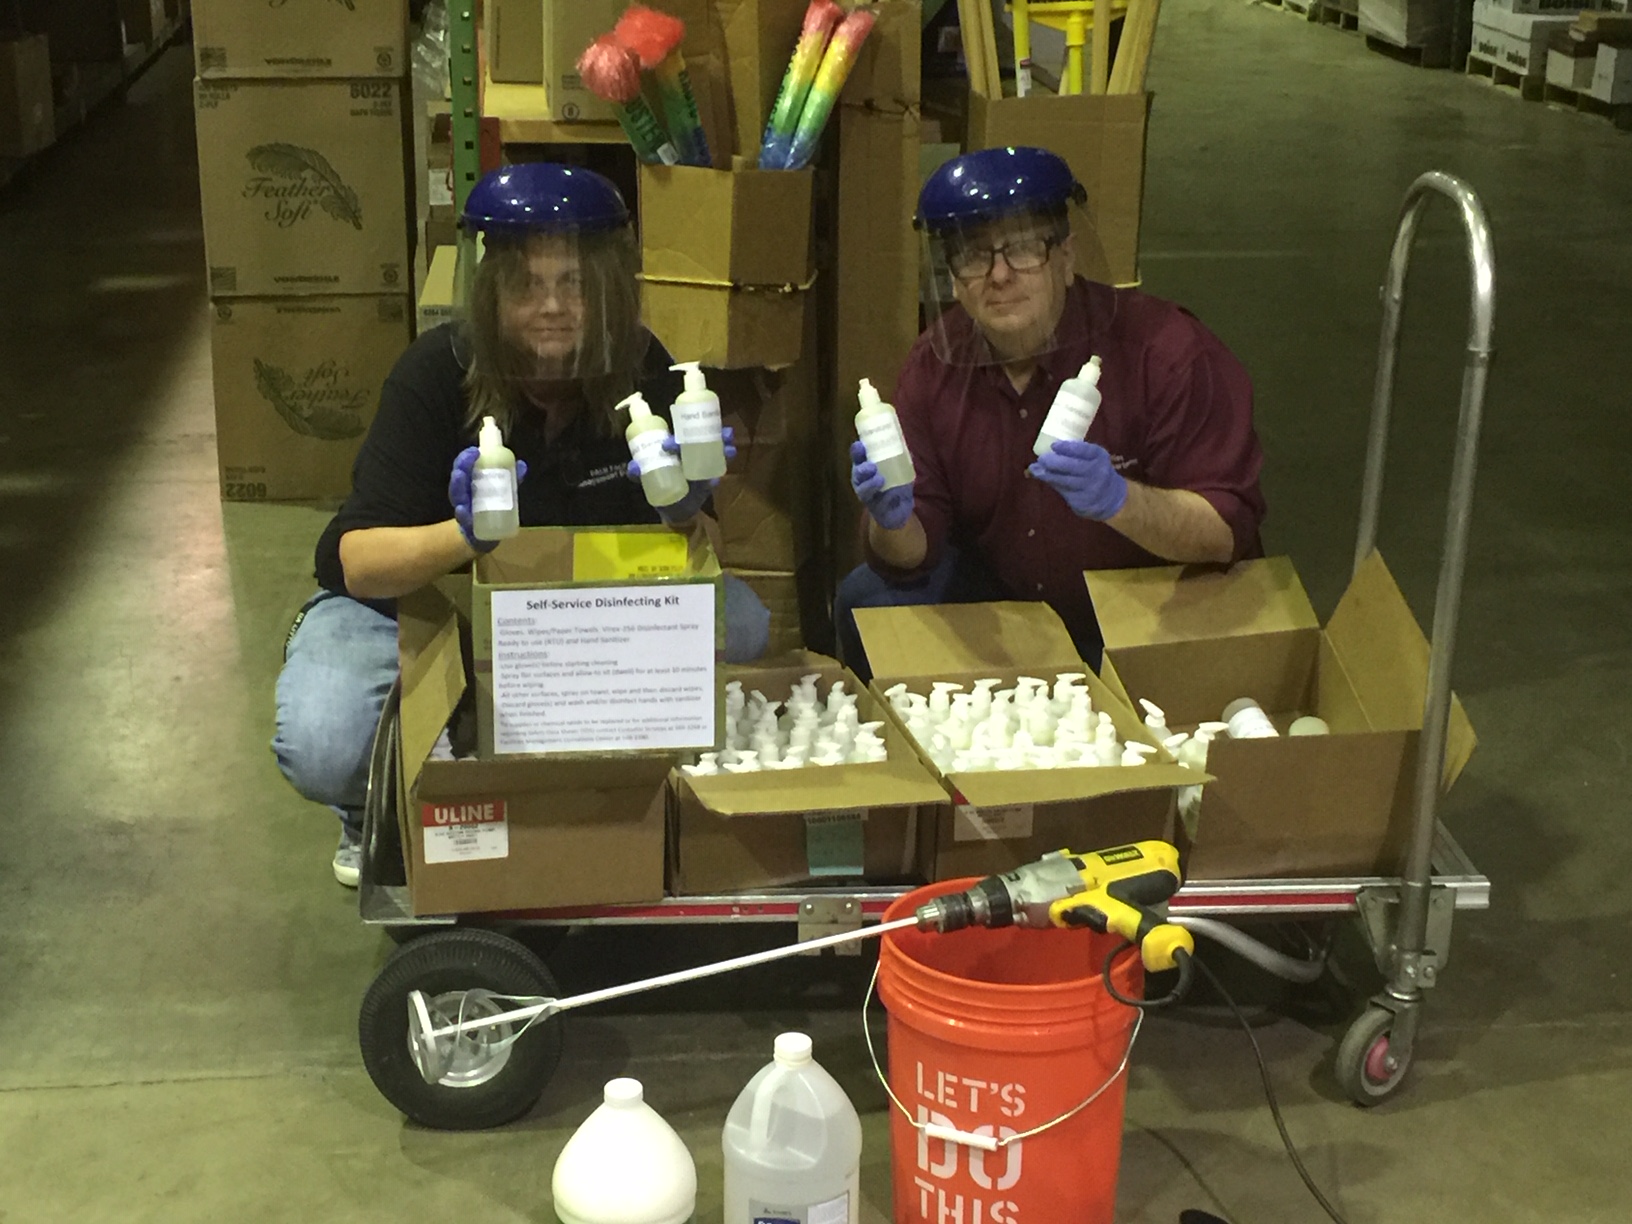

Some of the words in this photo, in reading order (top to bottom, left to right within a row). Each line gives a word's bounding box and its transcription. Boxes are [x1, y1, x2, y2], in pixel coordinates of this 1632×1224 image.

[350, 83, 392, 99] 6022
[241, 176, 330, 198] Feather
[264, 199, 313, 228] Soft
[285, 388, 371, 409] Feather
[226, 483, 267, 498] 6022
[526, 598, 592, 610] Self-Service
[595, 596, 662, 608] Disinfecting
[664, 595, 680, 606] Kit
[434, 803, 494, 824] ULINE
[917, 1060, 1026, 1117] LET'S
[917, 1103, 1023, 1190] DO
[914, 1175, 1021, 1224] THIS
